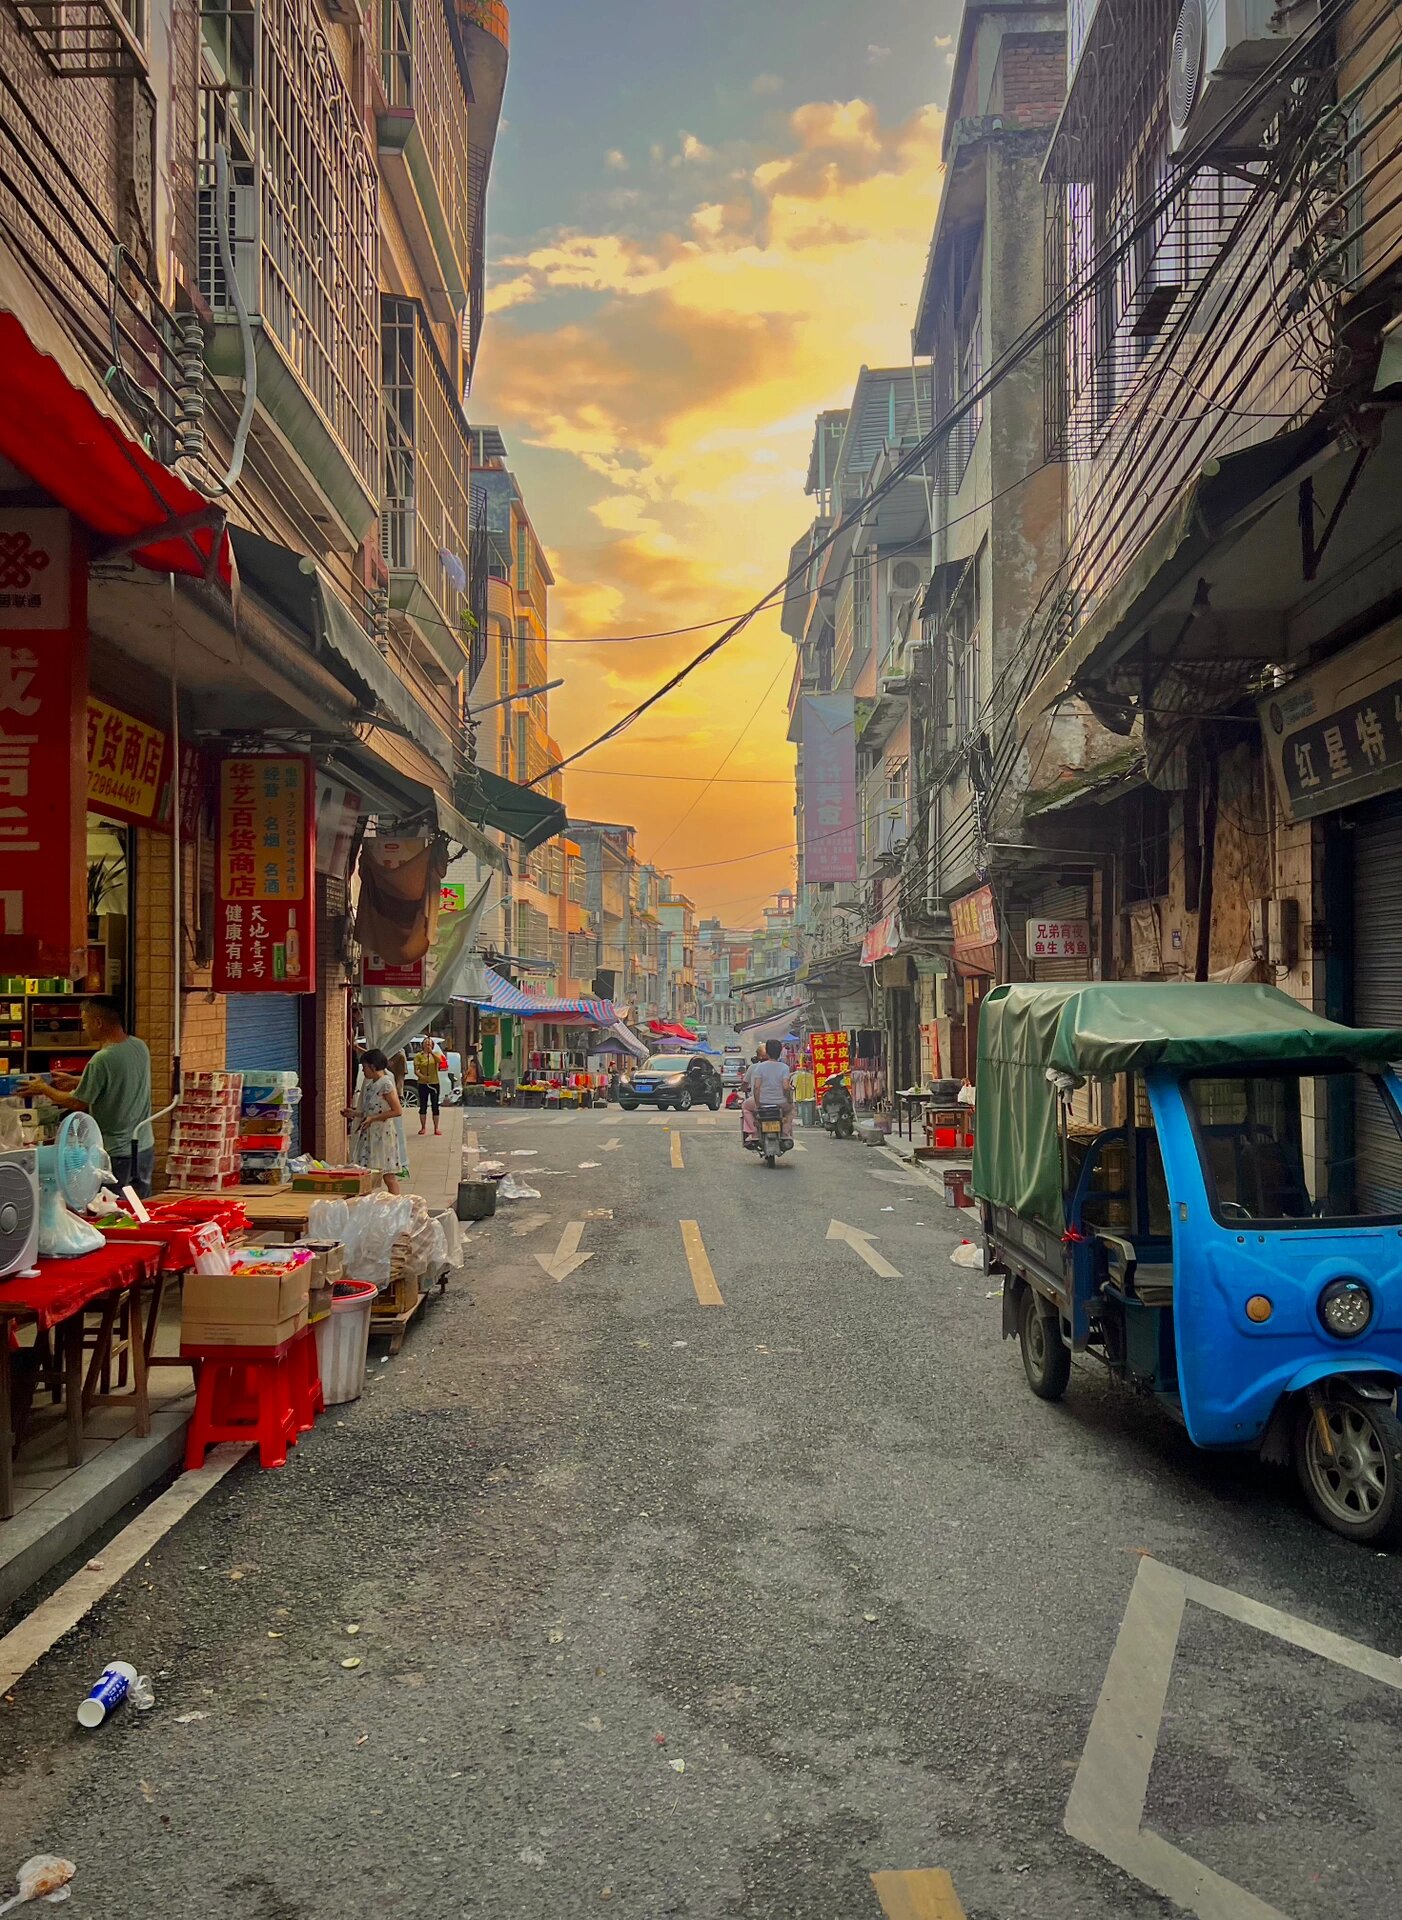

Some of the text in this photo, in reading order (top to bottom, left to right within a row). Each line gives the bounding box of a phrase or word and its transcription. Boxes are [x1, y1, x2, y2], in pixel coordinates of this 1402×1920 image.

[228, 763, 257, 897] 华艺百货商店
[1036, 923, 1084, 939] 兄弟宵夜
[225, 904, 244, 979] 健康有请
[247, 905, 270, 978] 天地壹号
[1034, 941, 1088, 955] 鱼生 烤鱼
[812, 1032, 848, 1046] 云吞皮
[813, 1046, 849, 1060] 饺子皮
[815, 1061, 850, 1075] 角子皮
